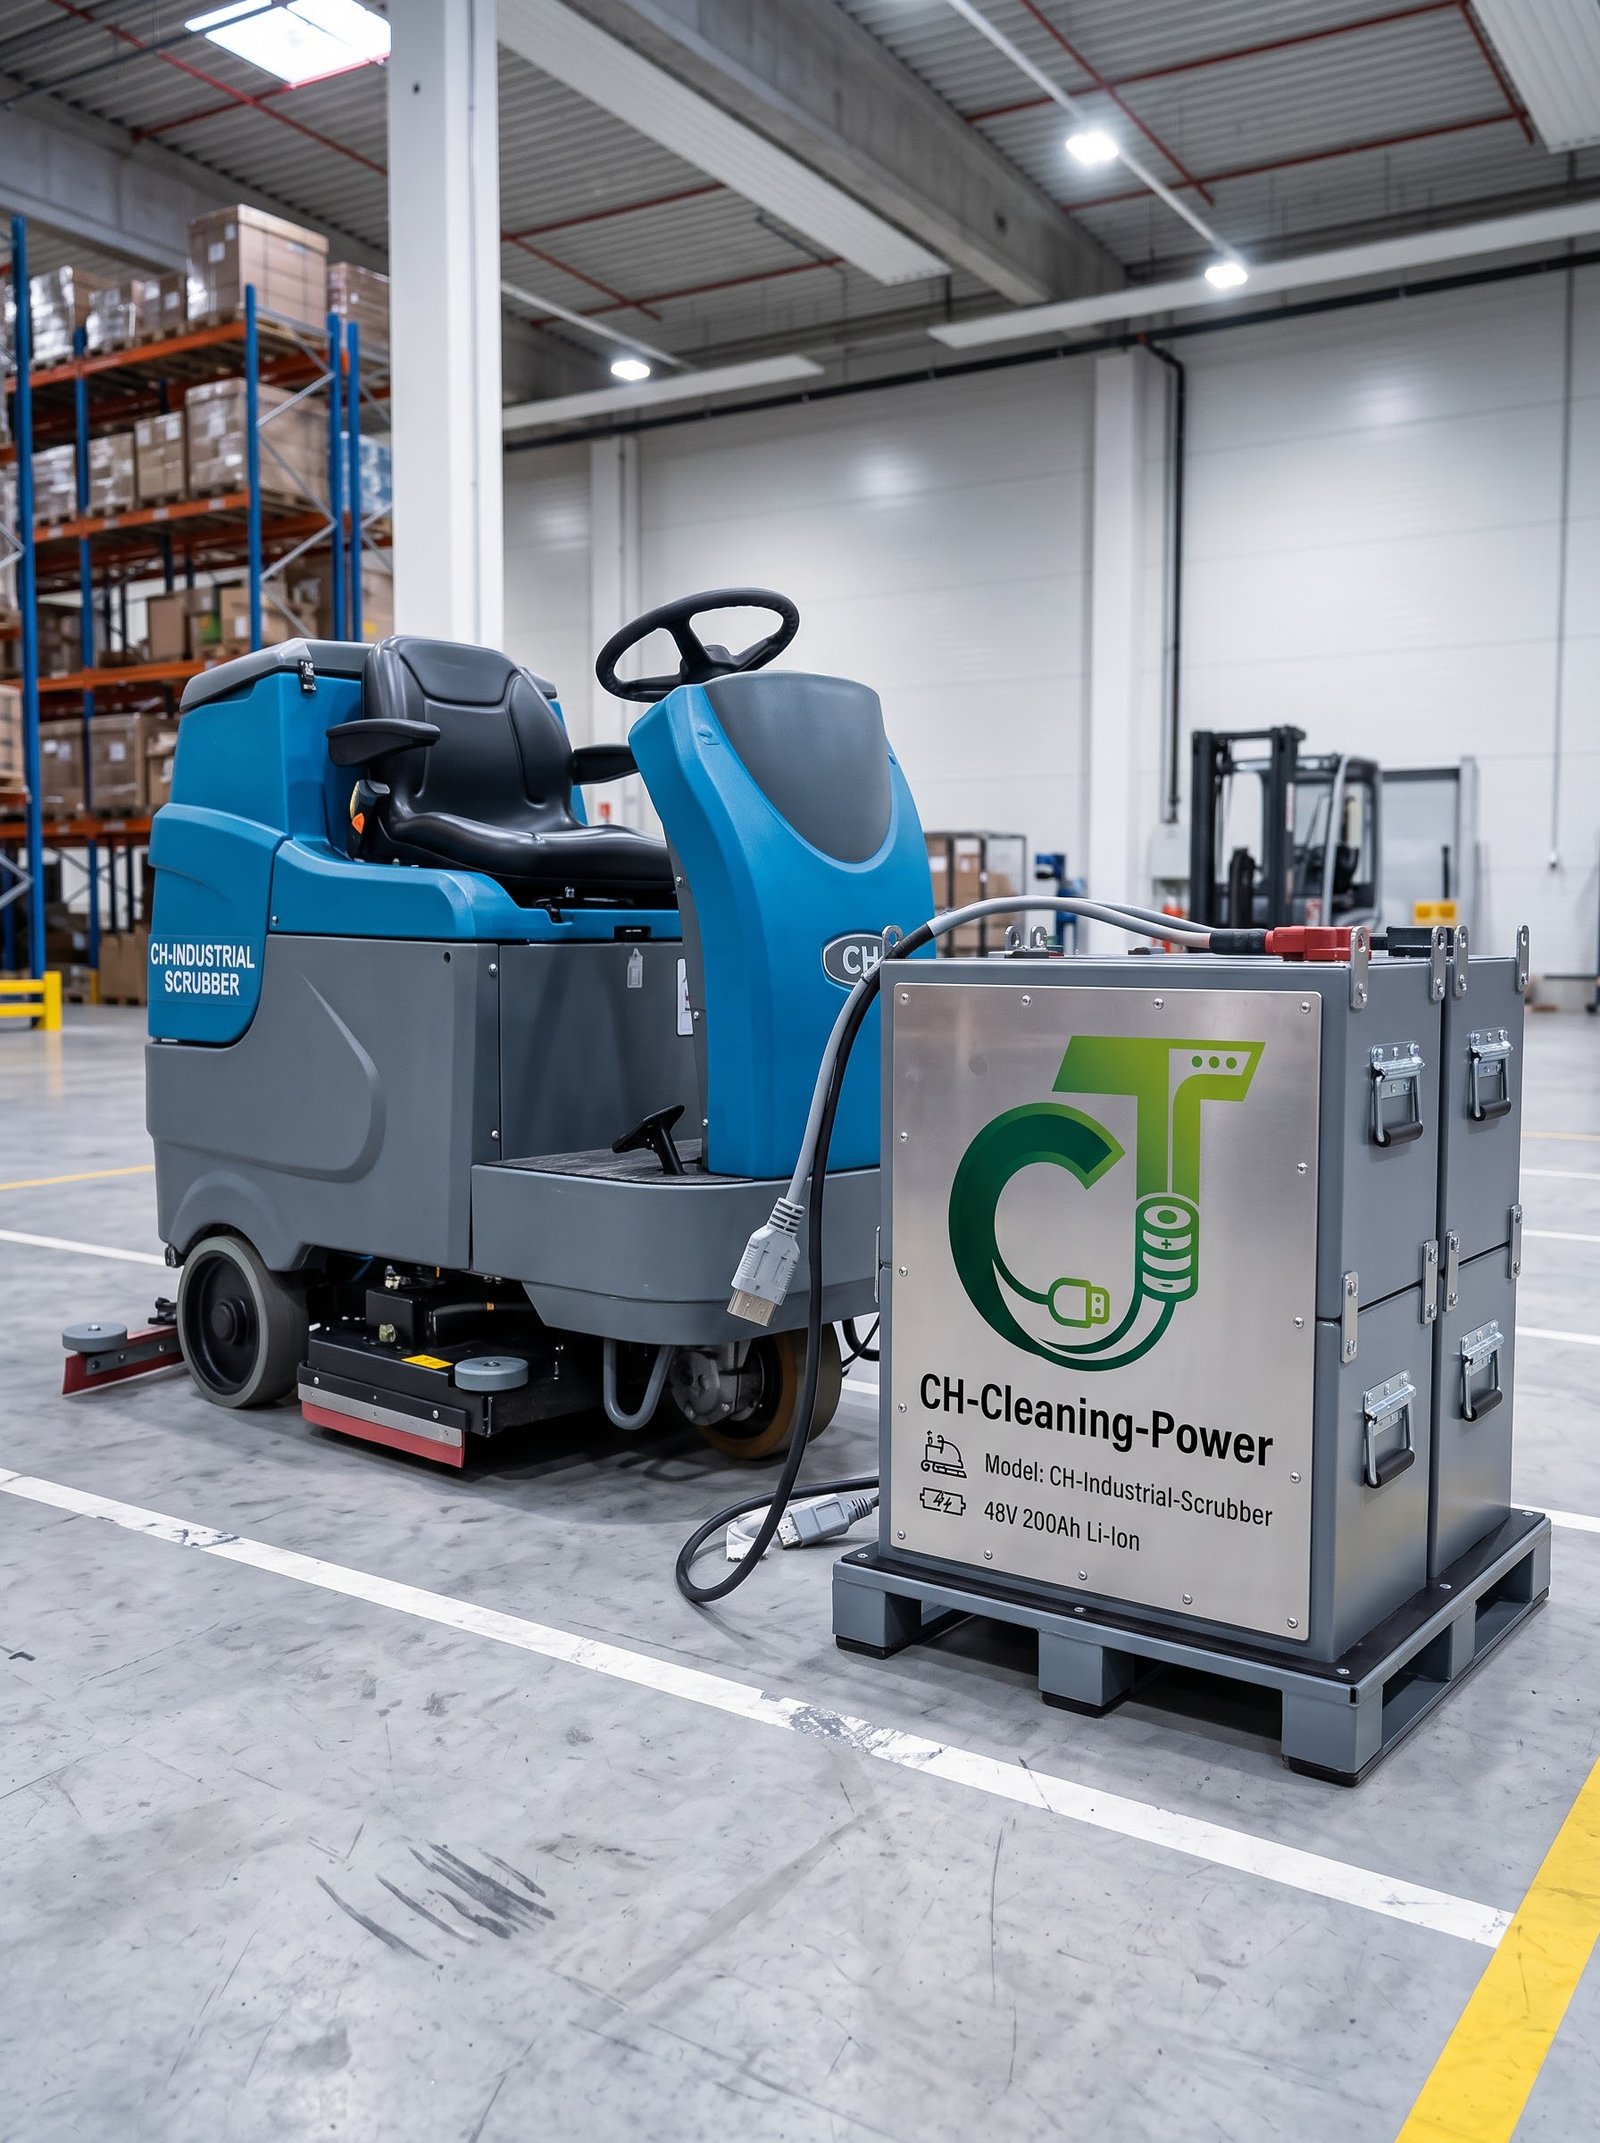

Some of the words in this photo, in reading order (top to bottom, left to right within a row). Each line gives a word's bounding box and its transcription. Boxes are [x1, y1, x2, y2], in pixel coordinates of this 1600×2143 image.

[150, 942, 255, 969] CH-INDUSTRIAL
[164, 970, 240, 996] SCRUBBER
[920, 1373, 1273, 1466] CH-Cleaning-Power
[985, 1453, 1044, 1483] Model:
[1050, 1465, 1273, 1527] CH-Industrial-Scrubber
[984, 1501, 1018, 1525] 48V
[1023, 1508, 1080, 1539] 200Ah
[1087, 1521, 1140, 1551] Li-Ion
